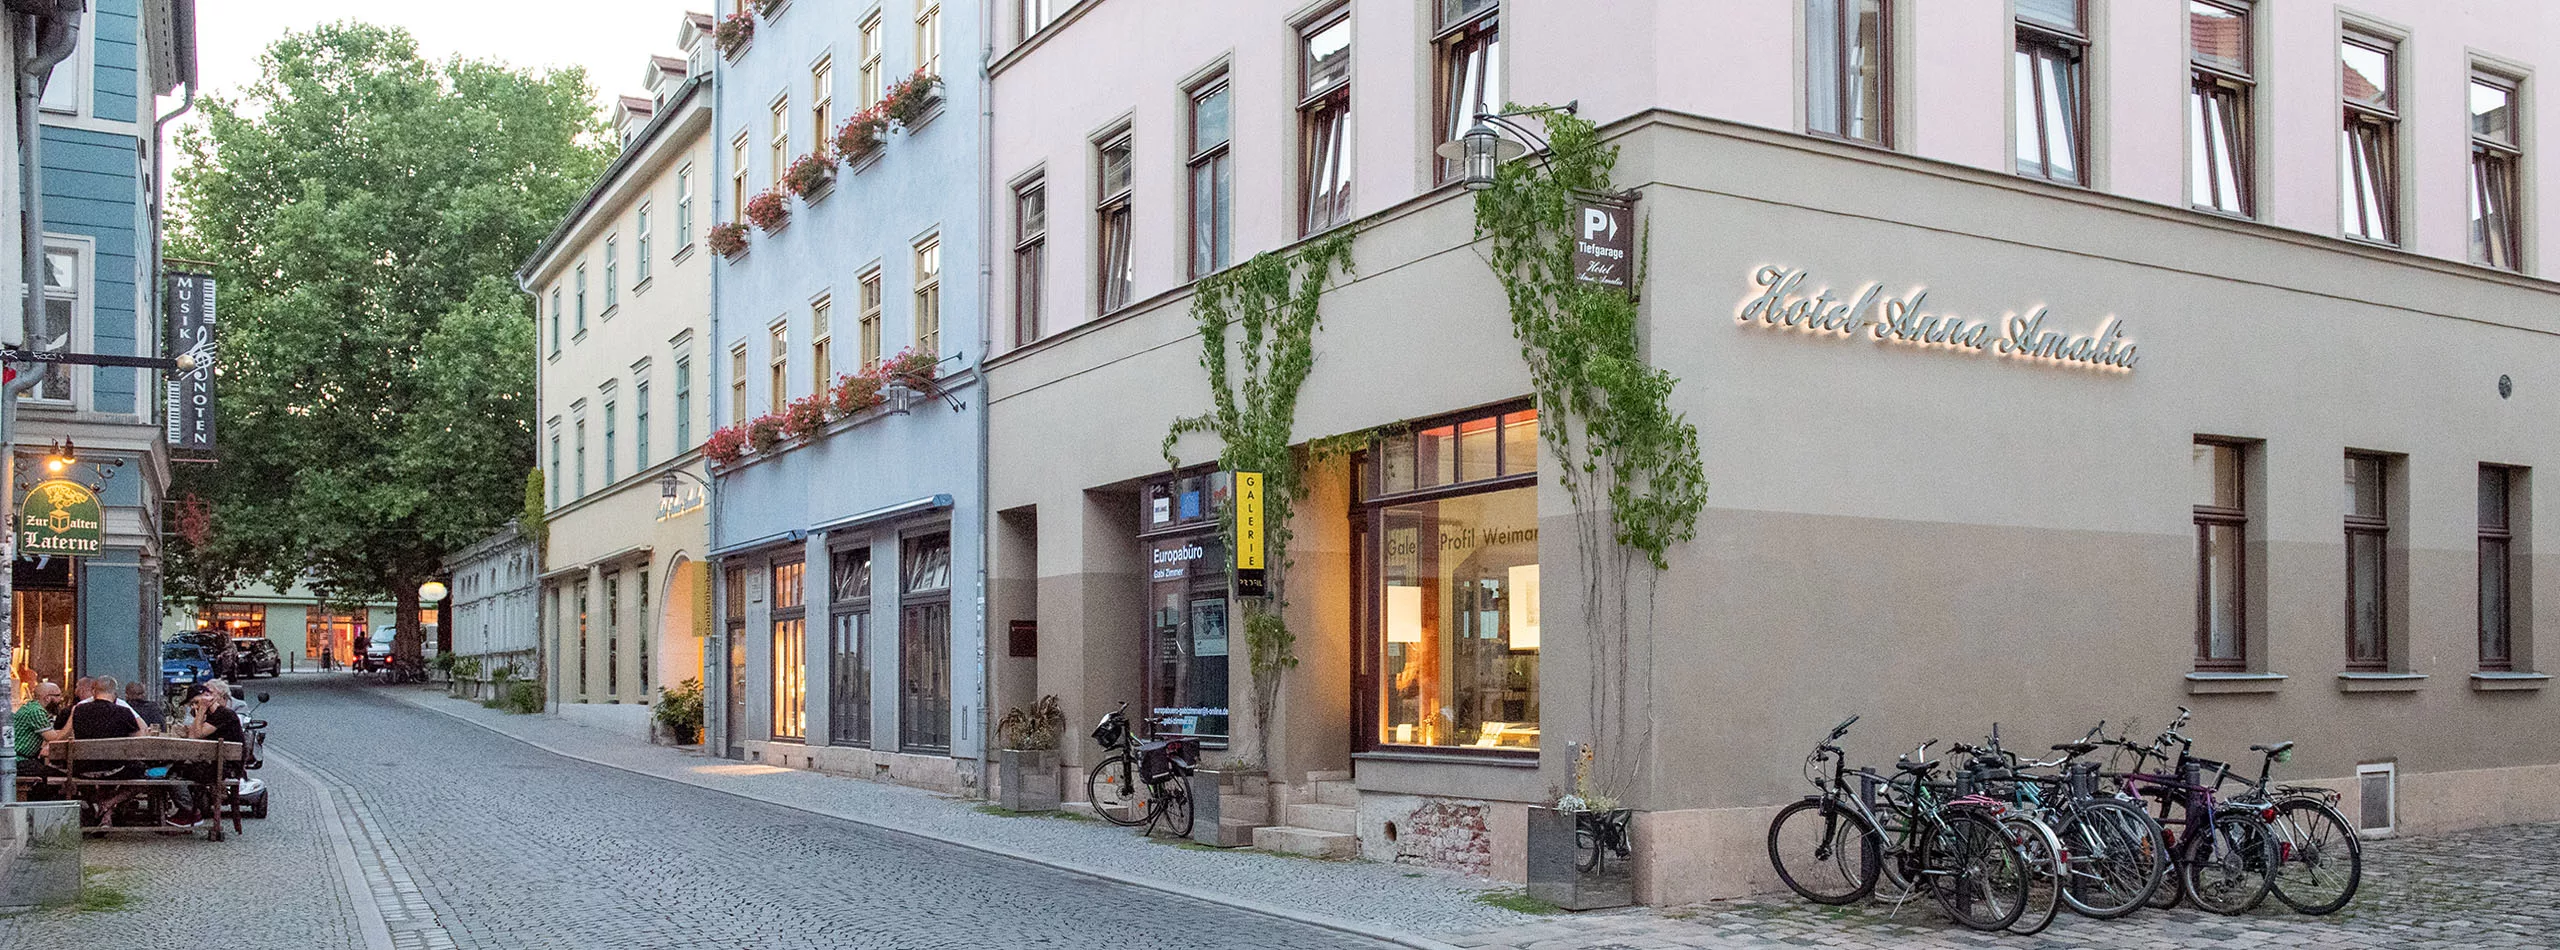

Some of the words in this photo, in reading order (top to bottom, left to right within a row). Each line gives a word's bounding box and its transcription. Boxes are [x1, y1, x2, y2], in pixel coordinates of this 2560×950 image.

[1584, 207, 1608, 240] P
[1579, 241, 1623, 259] Tiefgarage
[1586, 260, 1615, 275] Hotel
[177, 277, 193, 339] MUSIK
[1741, 265, 1883, 334] Hotel
[1874, 288, 1992, 350] Anna
[1999, 306, 2140, 369] Amalia
[193, 382, 207, 444] NOTEN
[26, 515, 49, 527] Zur
[70, 518, 98, 530] alten
[1246, 477, 1255, 566] GALERIE
[24, 531, 98, 551] Laterne
[1440, 528, 1475, 550] Profil
[1153, 543, 1203, 565] Europabüro
[1153, 569, 1165, 579] Gabi
[1166, 567, 1184, 578] Zimmer
